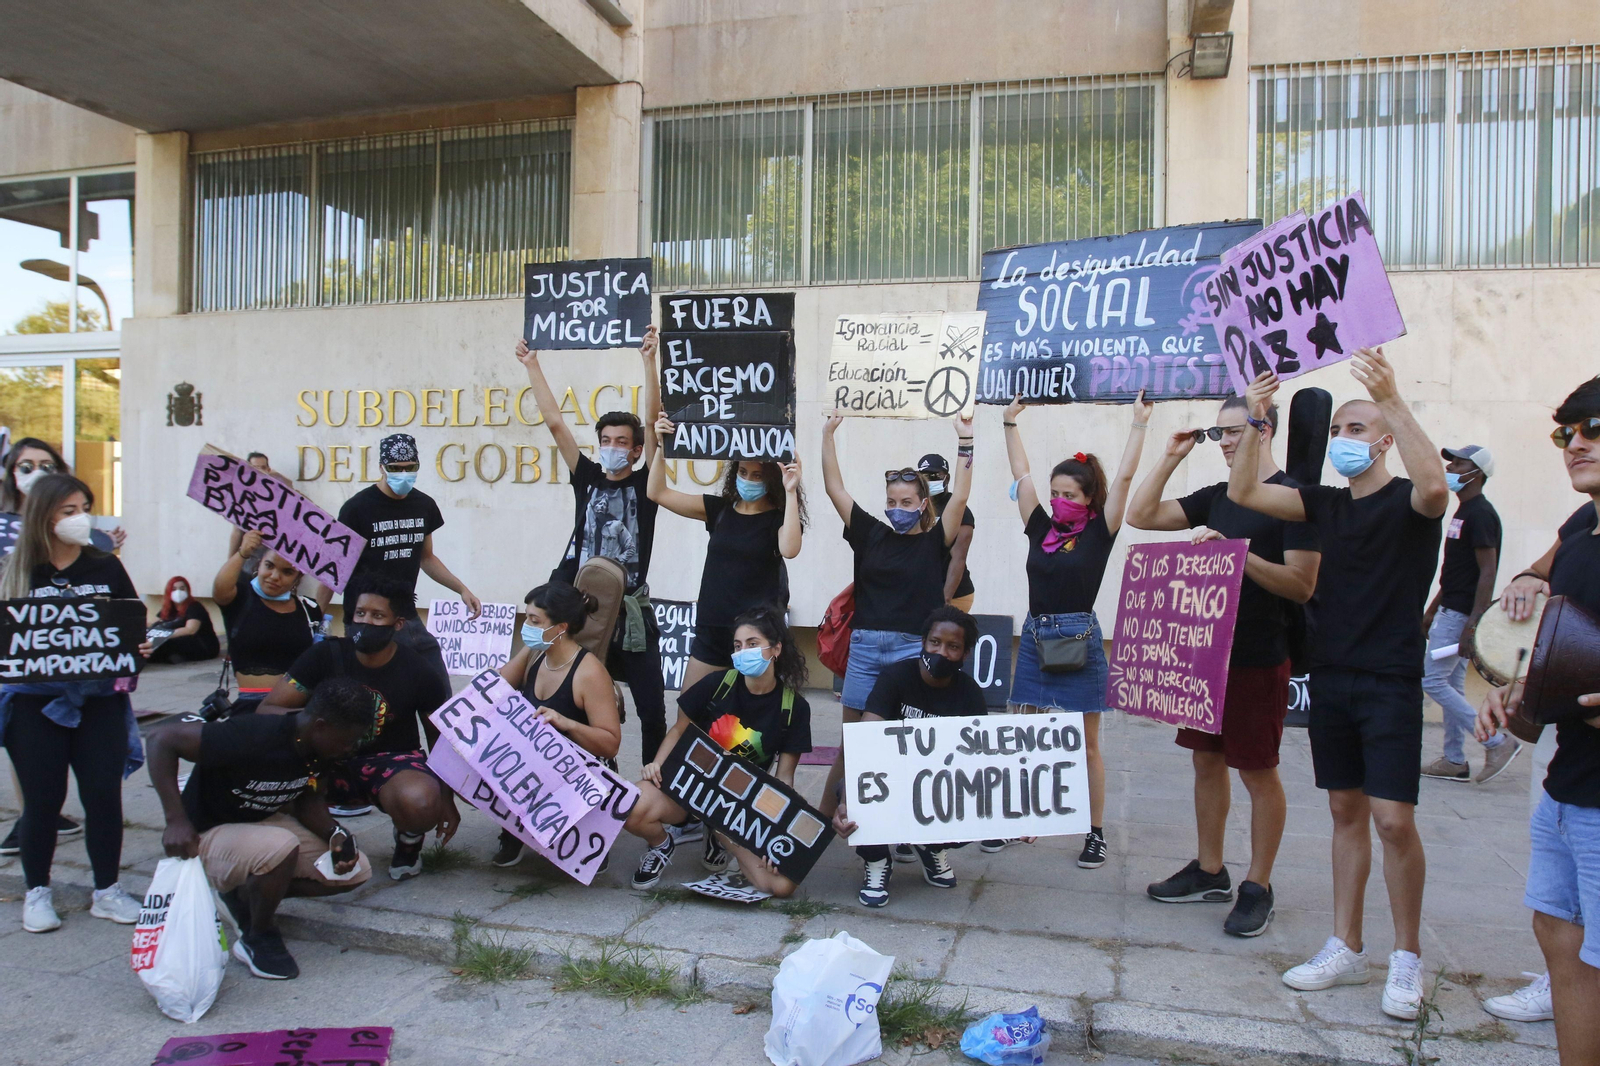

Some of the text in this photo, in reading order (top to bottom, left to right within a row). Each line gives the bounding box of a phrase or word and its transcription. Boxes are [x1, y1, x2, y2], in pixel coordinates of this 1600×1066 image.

[991, 231, 1203, 292] La desigualdad
[1206, 197, 1373, 317] SIN JUSTICIA
[1015, 276, 1156, 337] SOCIAL
[1246, 254, 1349, 329] NO HAY
[566, 297, 608, 319] POR
[669, 296, 773, 330] FUERA
[835, 318, 920, 341] Ignorancia
[857, 336, 909, 351] Racial
[669, 338, 704, 366] EL
[984, 342, 1003, 363] ES
[1061, 335, 1151, 358] VIOLENTA
[1161, 335, 1205, 354] QUE
[1225, 325, 1301, 385] PAZ
[663, 362, 776, 395] RACISMO
[828, 361, 908, 382] Educación
[296, 384, 643, 428] SUBDELEGACI
[699, 393, 736, 420] DE
[834, 385, 909, 411] Racial
[297, 445, 382, 482] DEL
[203, 467, 279, 530] PARA
[203, 485, 339, 586] BREONNA
[1151, 554, 1170, 578] LOS
[1175, 552, 1236, 576] DERECHOS
[6, 603, 100, 626] VIDAS
[433, 601, 459, 616] LOS
[1125, 580, 1228, 619] QUE YO TENGO
[9, 625, 121, 656] NEGRAS
[435, 619, 513, 636] UNIDOS JAMAS
[1122, 617, 1214, 648] NO LOS TIENEN
[0, 652, 136, 678] IMPORTAM
[1116, 642, 1138, 662] LOS
[1126, 666, 1137, 682] NO
[1139, 667, 1154, 684] SON
[1117, 681, 1143, 710] SON
[471, 668, 501, 705] EL
[496, 694, 564, 761] SILENCIO
[552, 741, 603, 807] BLANCO
[884, 726, 936, 756] TU
[439, 697, 570, 845] ES VIOLENCIA
[857, 771, 890, 804] ES
[669, 765, 795, 865] HUMAN@
